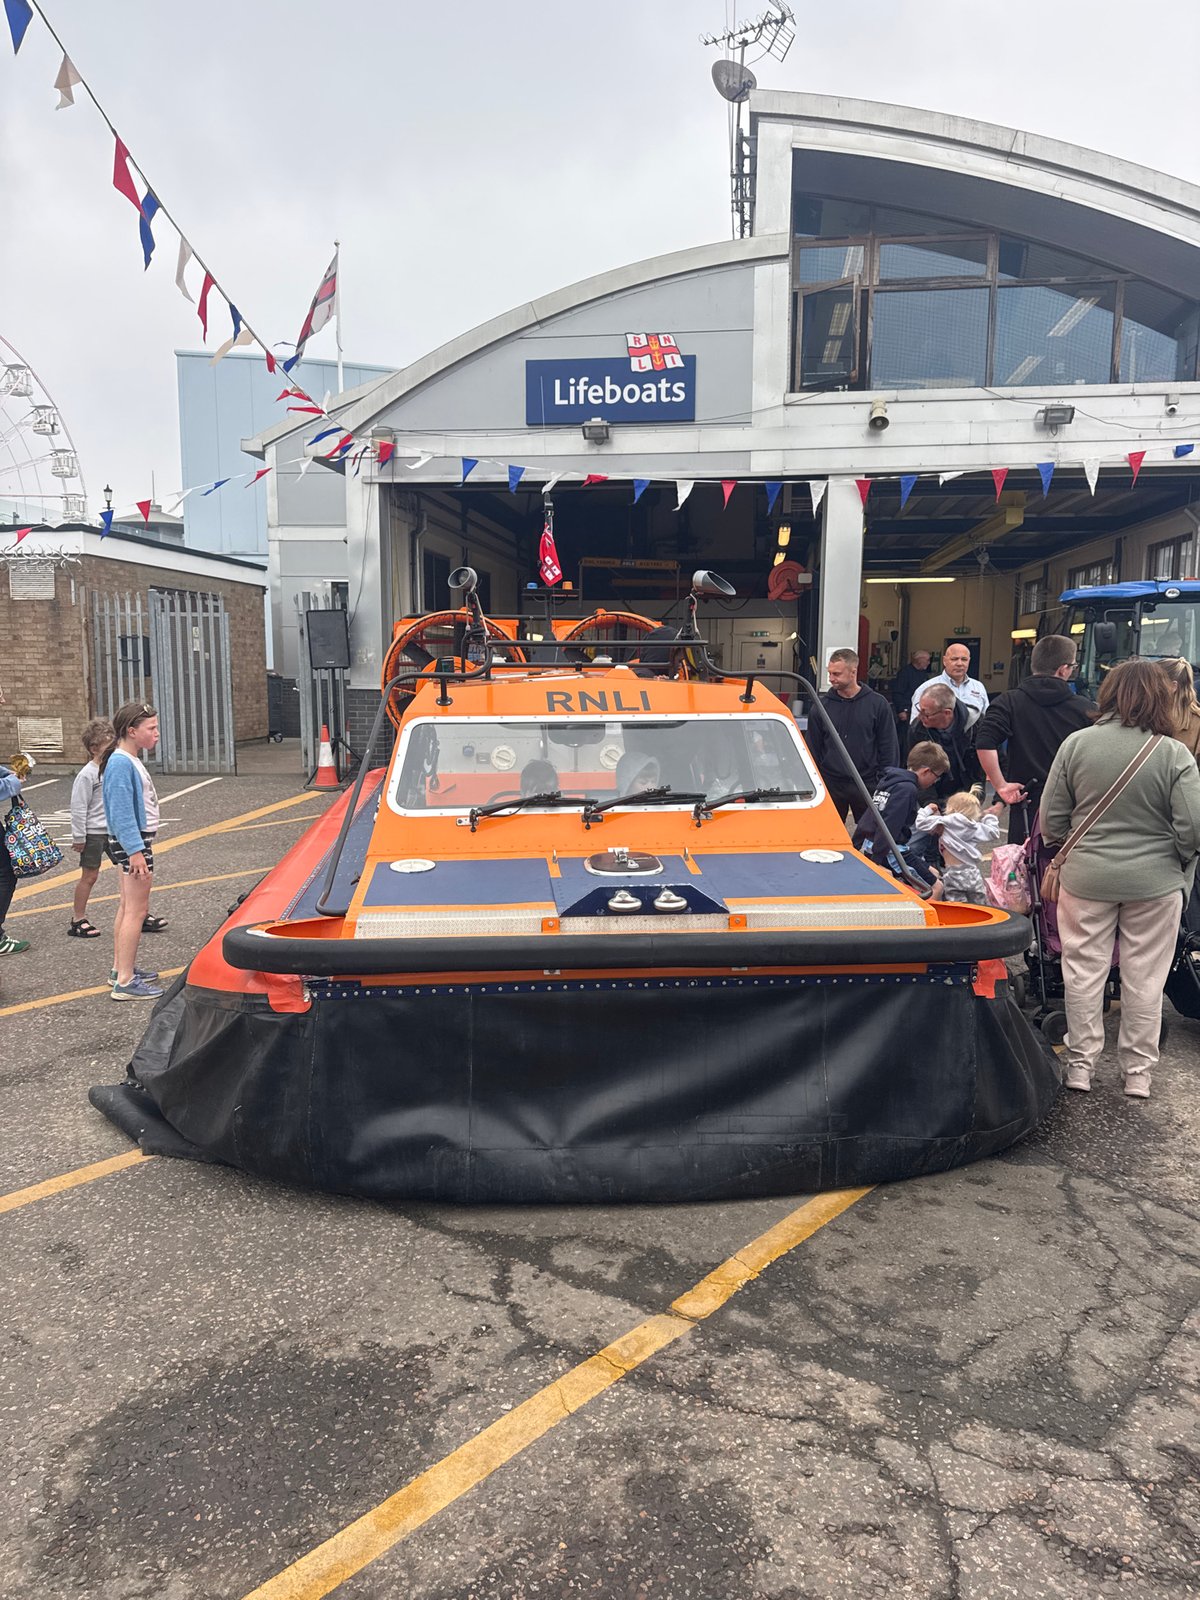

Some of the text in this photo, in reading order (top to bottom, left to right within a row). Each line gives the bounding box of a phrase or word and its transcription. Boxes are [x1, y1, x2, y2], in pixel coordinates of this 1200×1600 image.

[633, 335, 671, 345] R N
[638, 359, 647, 370] L
[554, 375, 686, 406] Lifeboats
[546, 690, 651, 712] RNLI
